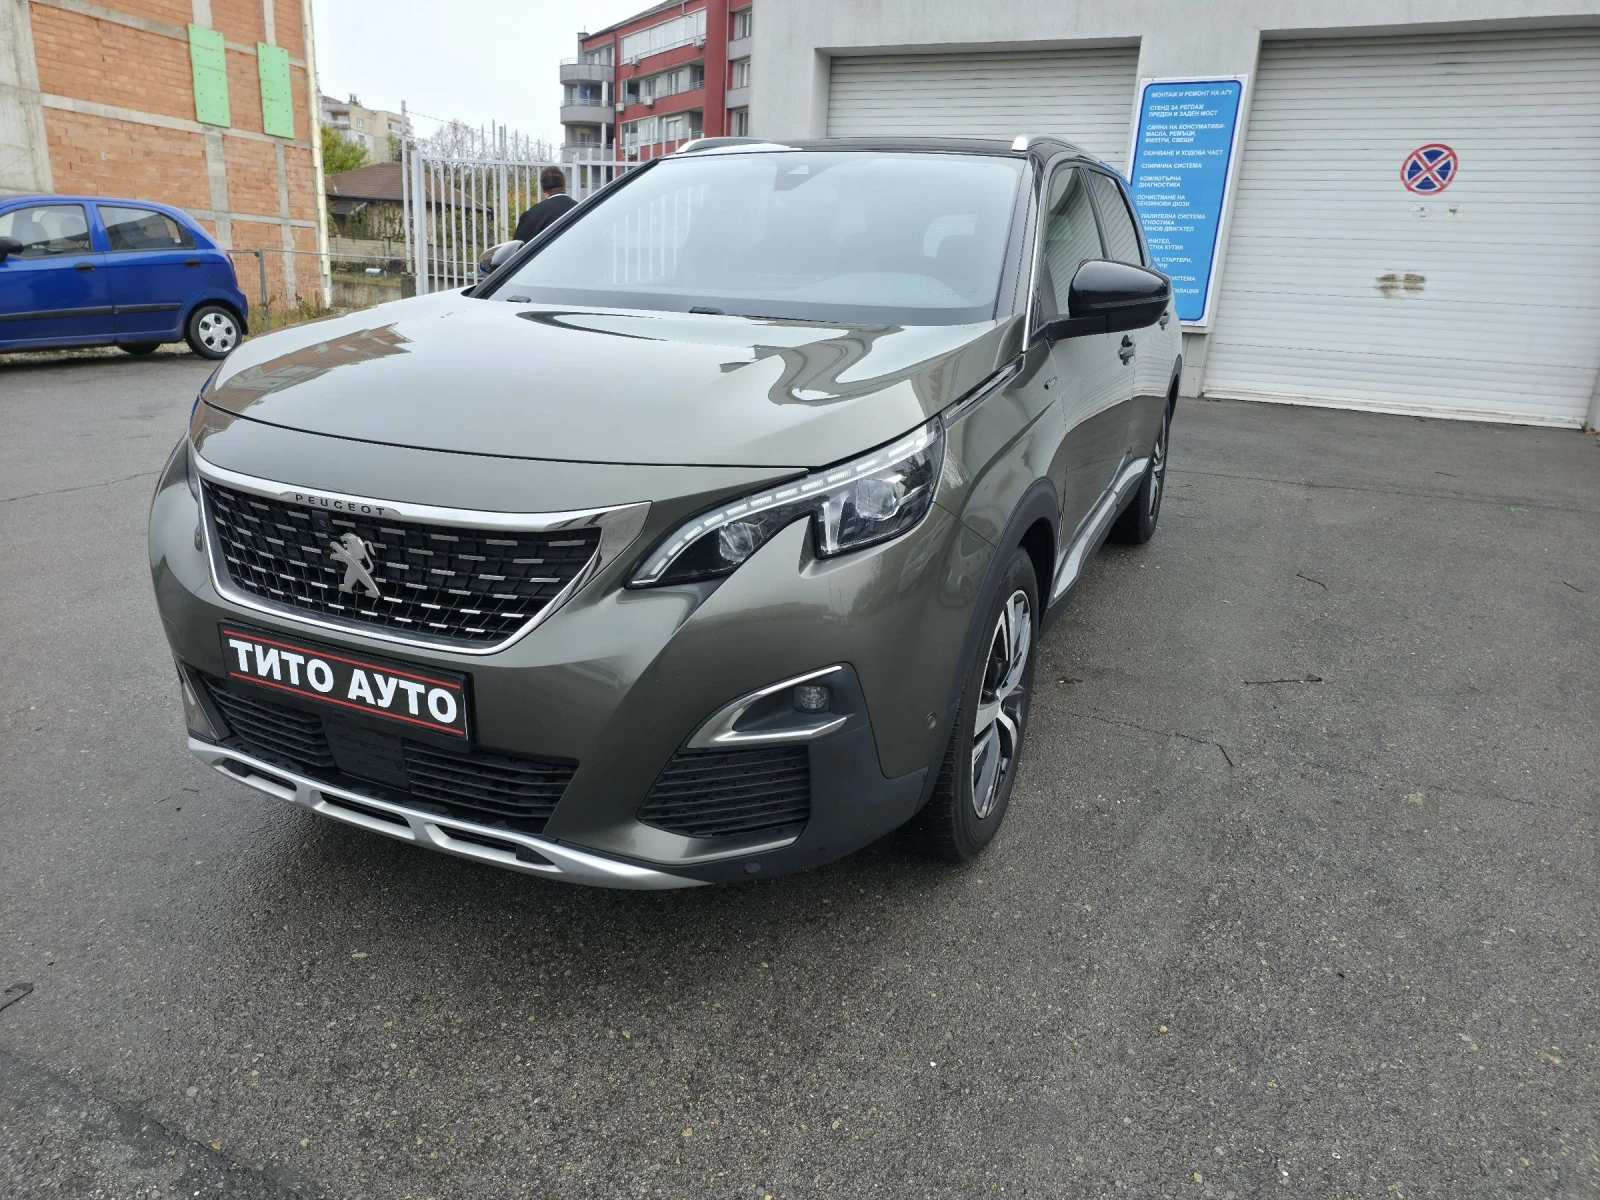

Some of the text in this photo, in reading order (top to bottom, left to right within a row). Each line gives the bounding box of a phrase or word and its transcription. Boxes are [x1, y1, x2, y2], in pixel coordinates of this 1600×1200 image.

[295, 494, 385, 516] PEUGEOT
[229, 638, 458, 724] ТИТО АУТО
